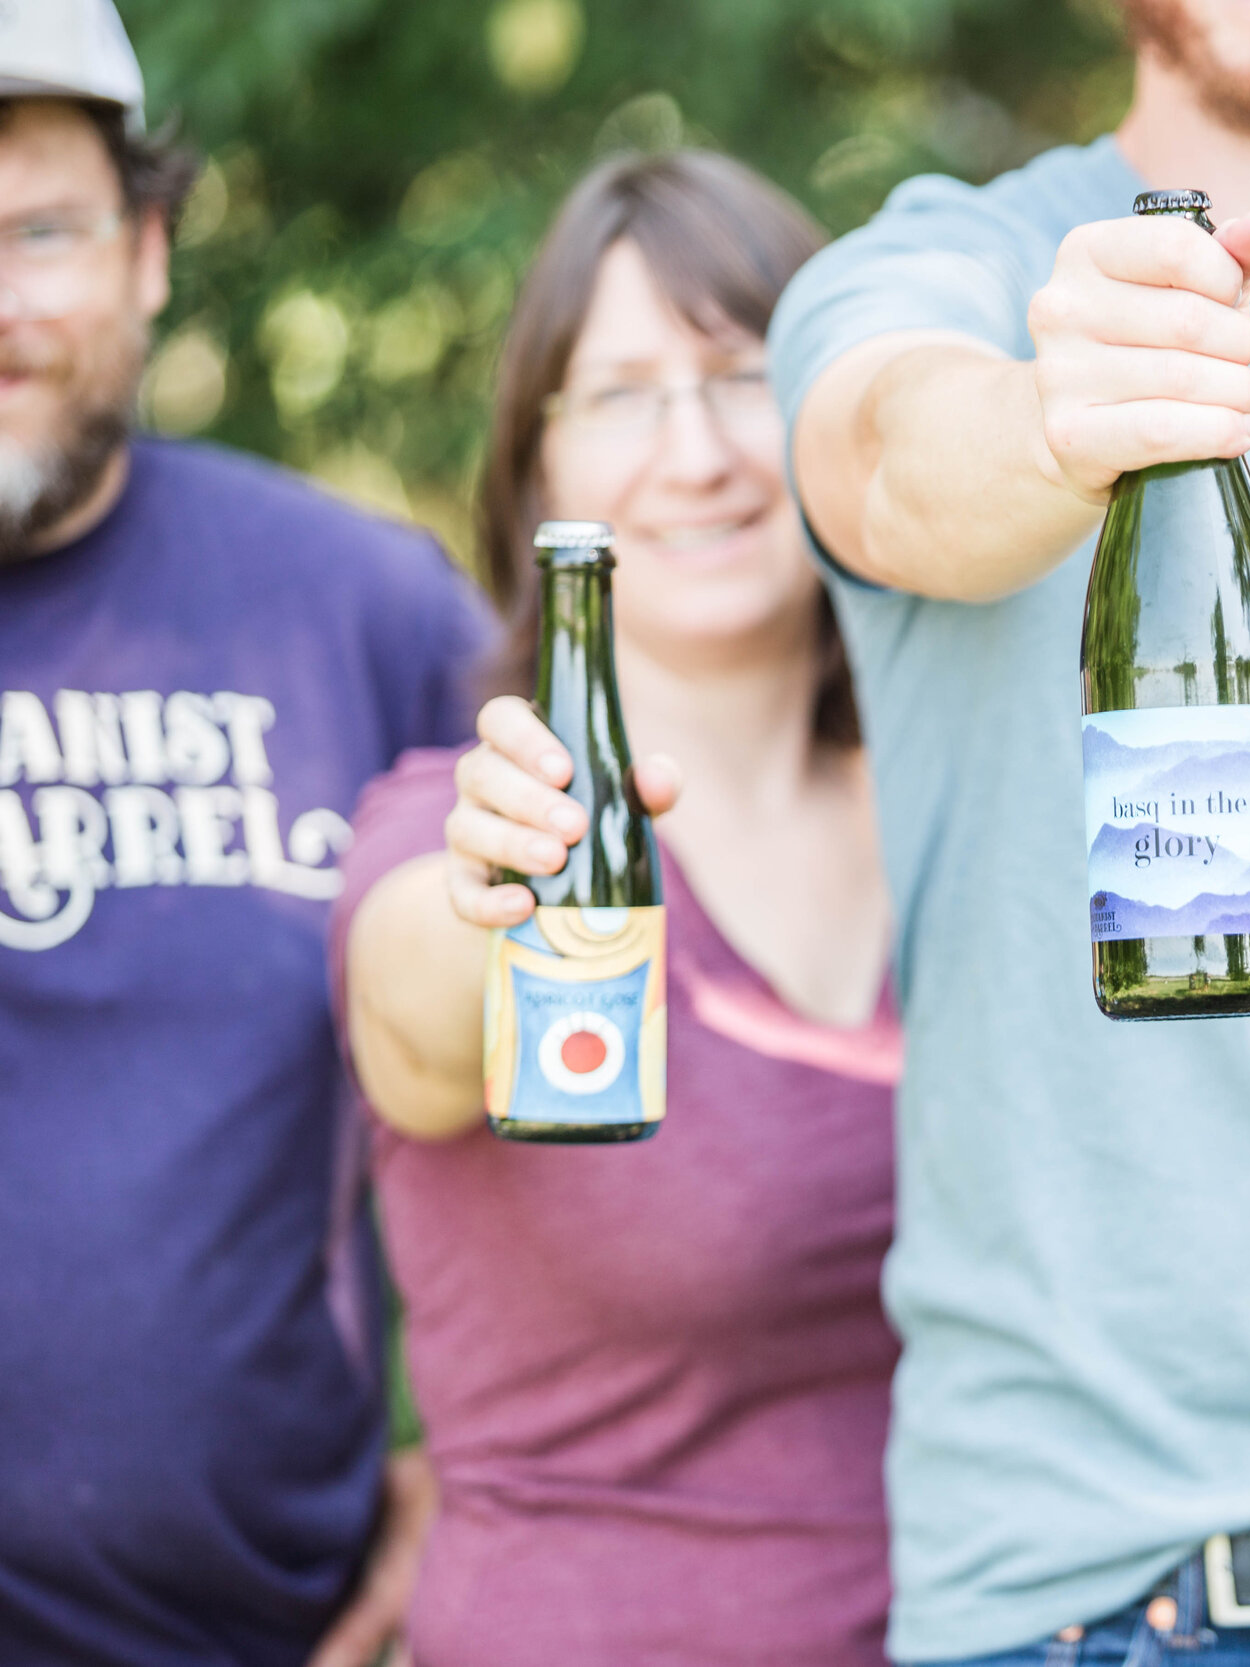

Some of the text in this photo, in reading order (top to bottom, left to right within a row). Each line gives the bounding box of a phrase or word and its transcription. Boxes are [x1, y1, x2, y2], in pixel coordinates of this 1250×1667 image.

[1113, 790, 1247, 823] basq in the
[1134, 827, 1220, 868] glory
